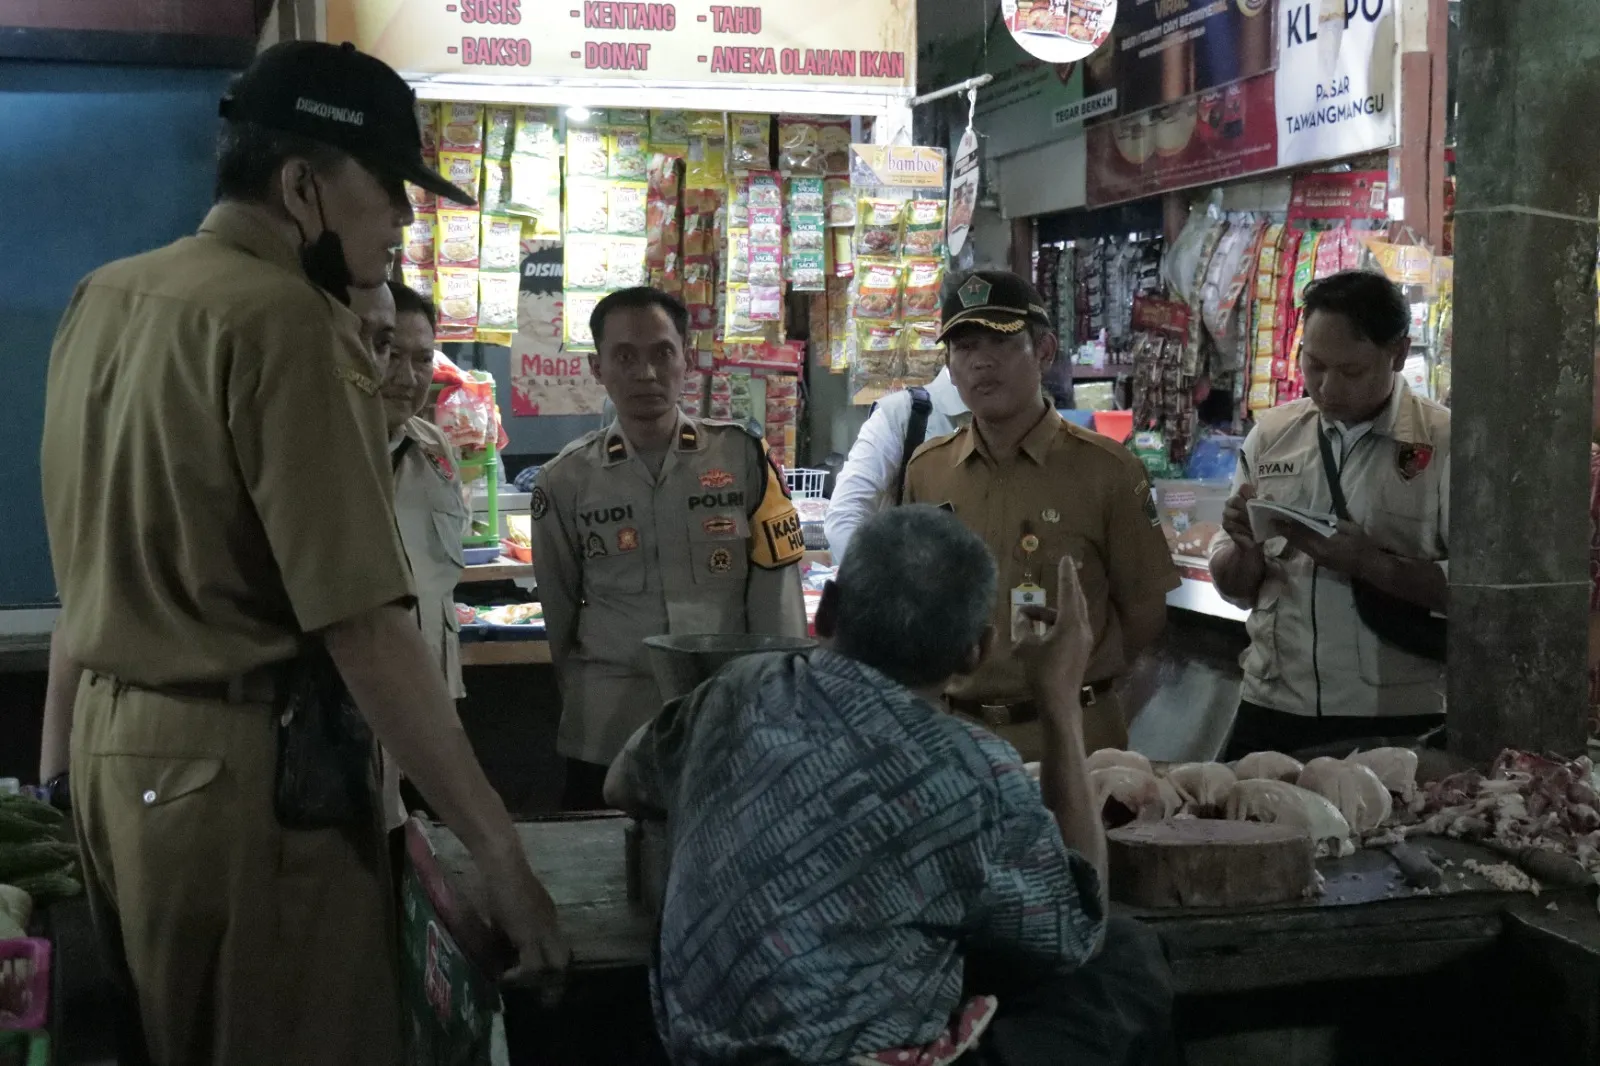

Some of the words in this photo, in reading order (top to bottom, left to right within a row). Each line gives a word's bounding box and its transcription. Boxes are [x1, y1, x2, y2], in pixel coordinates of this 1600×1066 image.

[461, 0, 521, 25] SOSIS
[584, 1, 676, 31] KENTANG
[710, 5, 762, 34] TAHU
[462, 36, 532, 66] BAKSO
[585, 41, 651, 71] DONAT
[711, 46, 777, 75] ANEKA
[780, 48, 856, 77] OLAHAN
[860, 51, 905, 78] IKAN
[1316, 75, 1350, 101] PASAR
[1055, 105, 1079, 123] TEGAR
[1081, 94, 1113, 116] BERKAH
[1286, 93, 1385, 134] TAWANGMANGU
[888, 149, 938, 172] bamboe
[521, 354, 582, 377] Mang
[1258, 463, 1294, 476] RYAN
[688, 491, 745, 511] POLRI
[579, 504, 634, 527] YUDI
